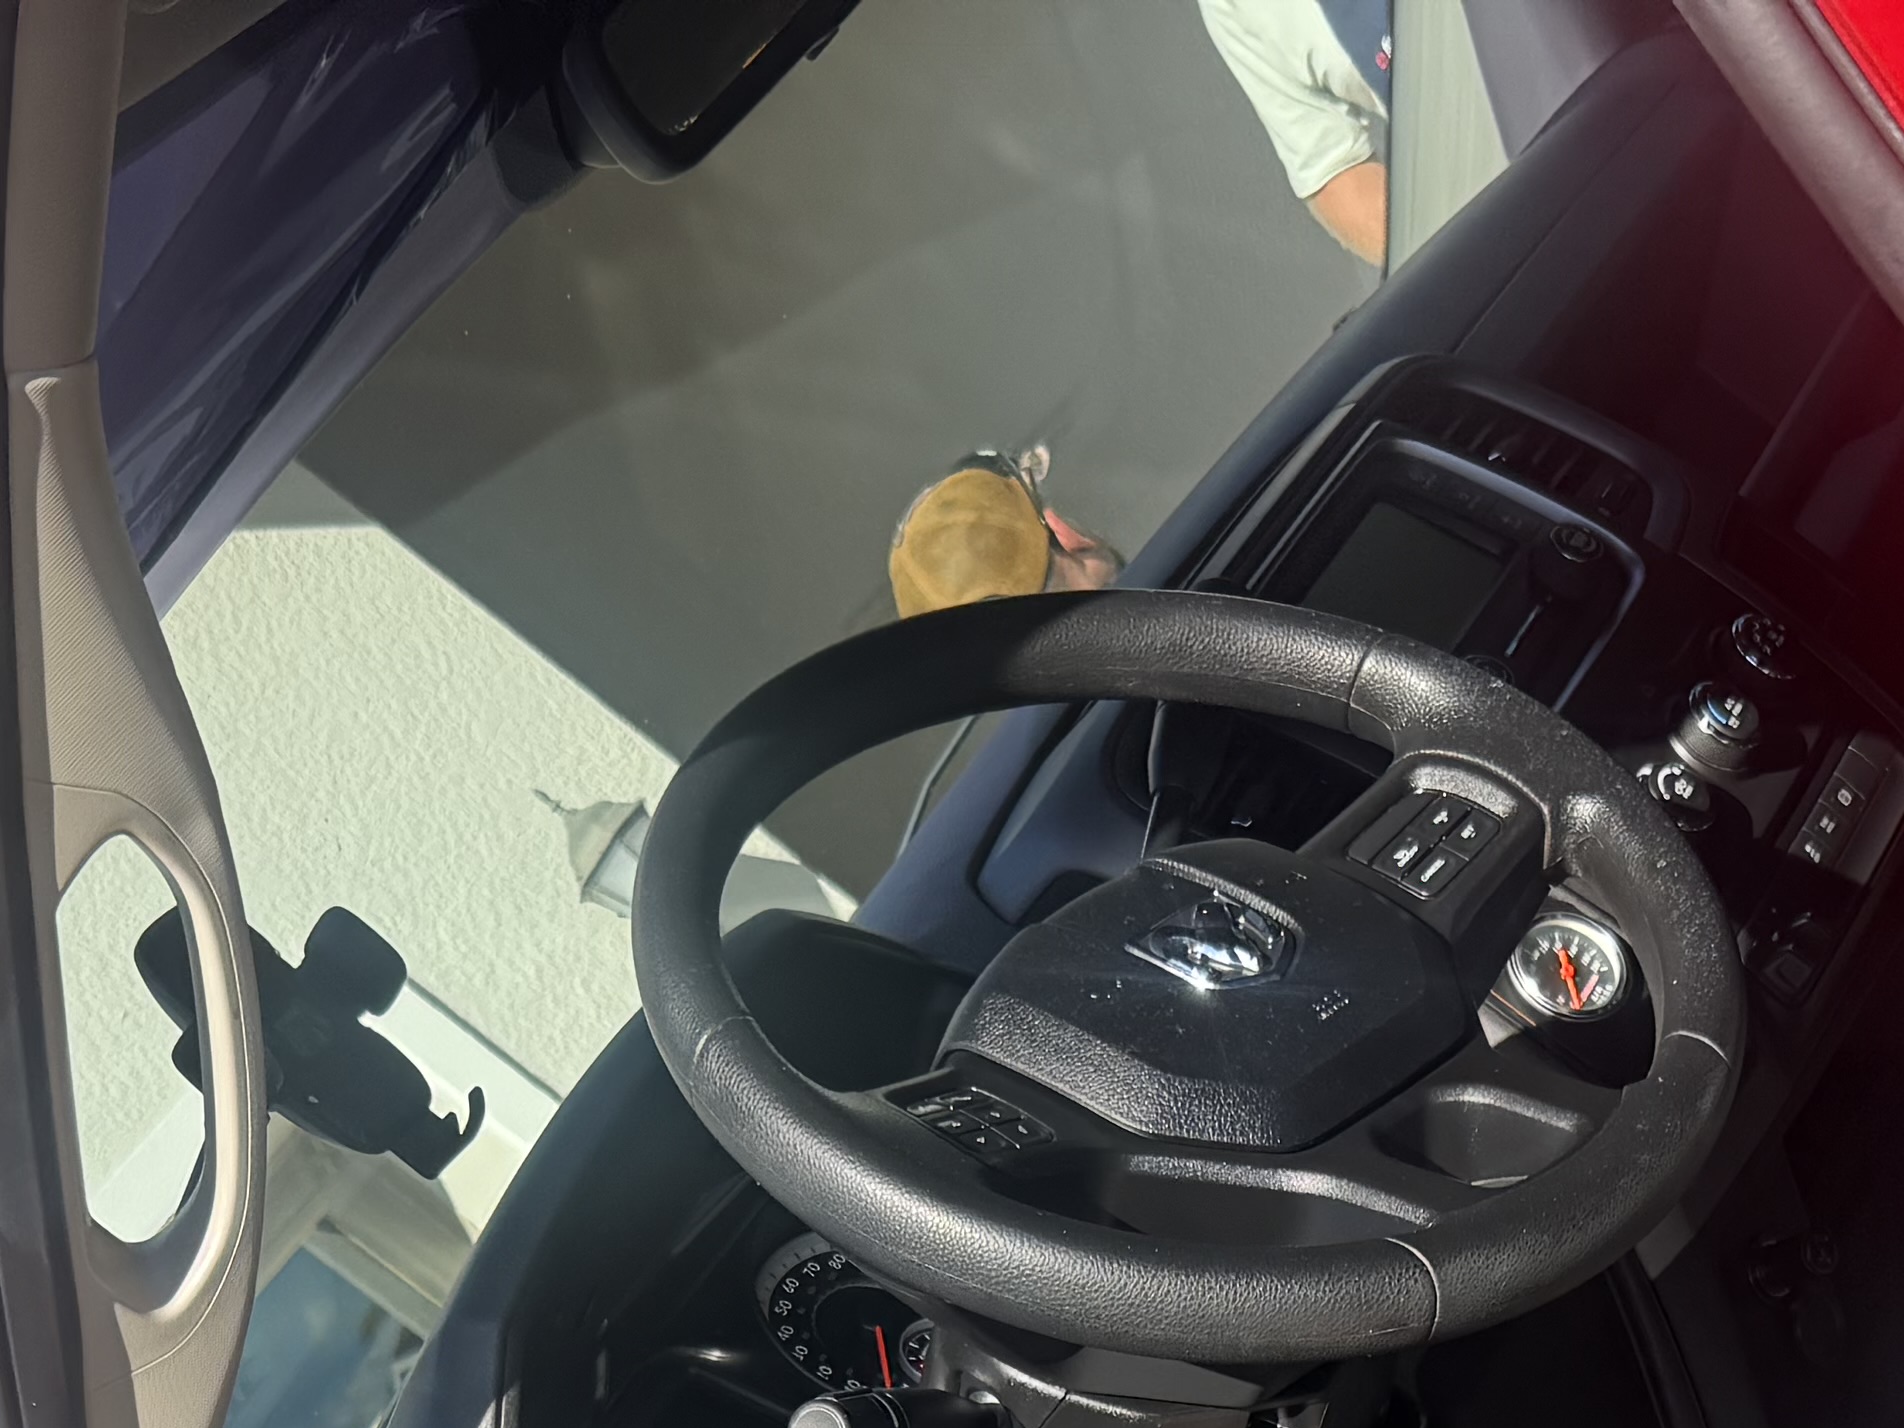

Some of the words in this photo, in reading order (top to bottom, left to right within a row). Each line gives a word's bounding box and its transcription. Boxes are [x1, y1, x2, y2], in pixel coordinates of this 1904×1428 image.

[802, 1262, 821, 1278] 70
[828, 1253, 846, 1270] 80
[782, 1277, 800, 1294] 60
[774, 1300, 793, 1317] 50
